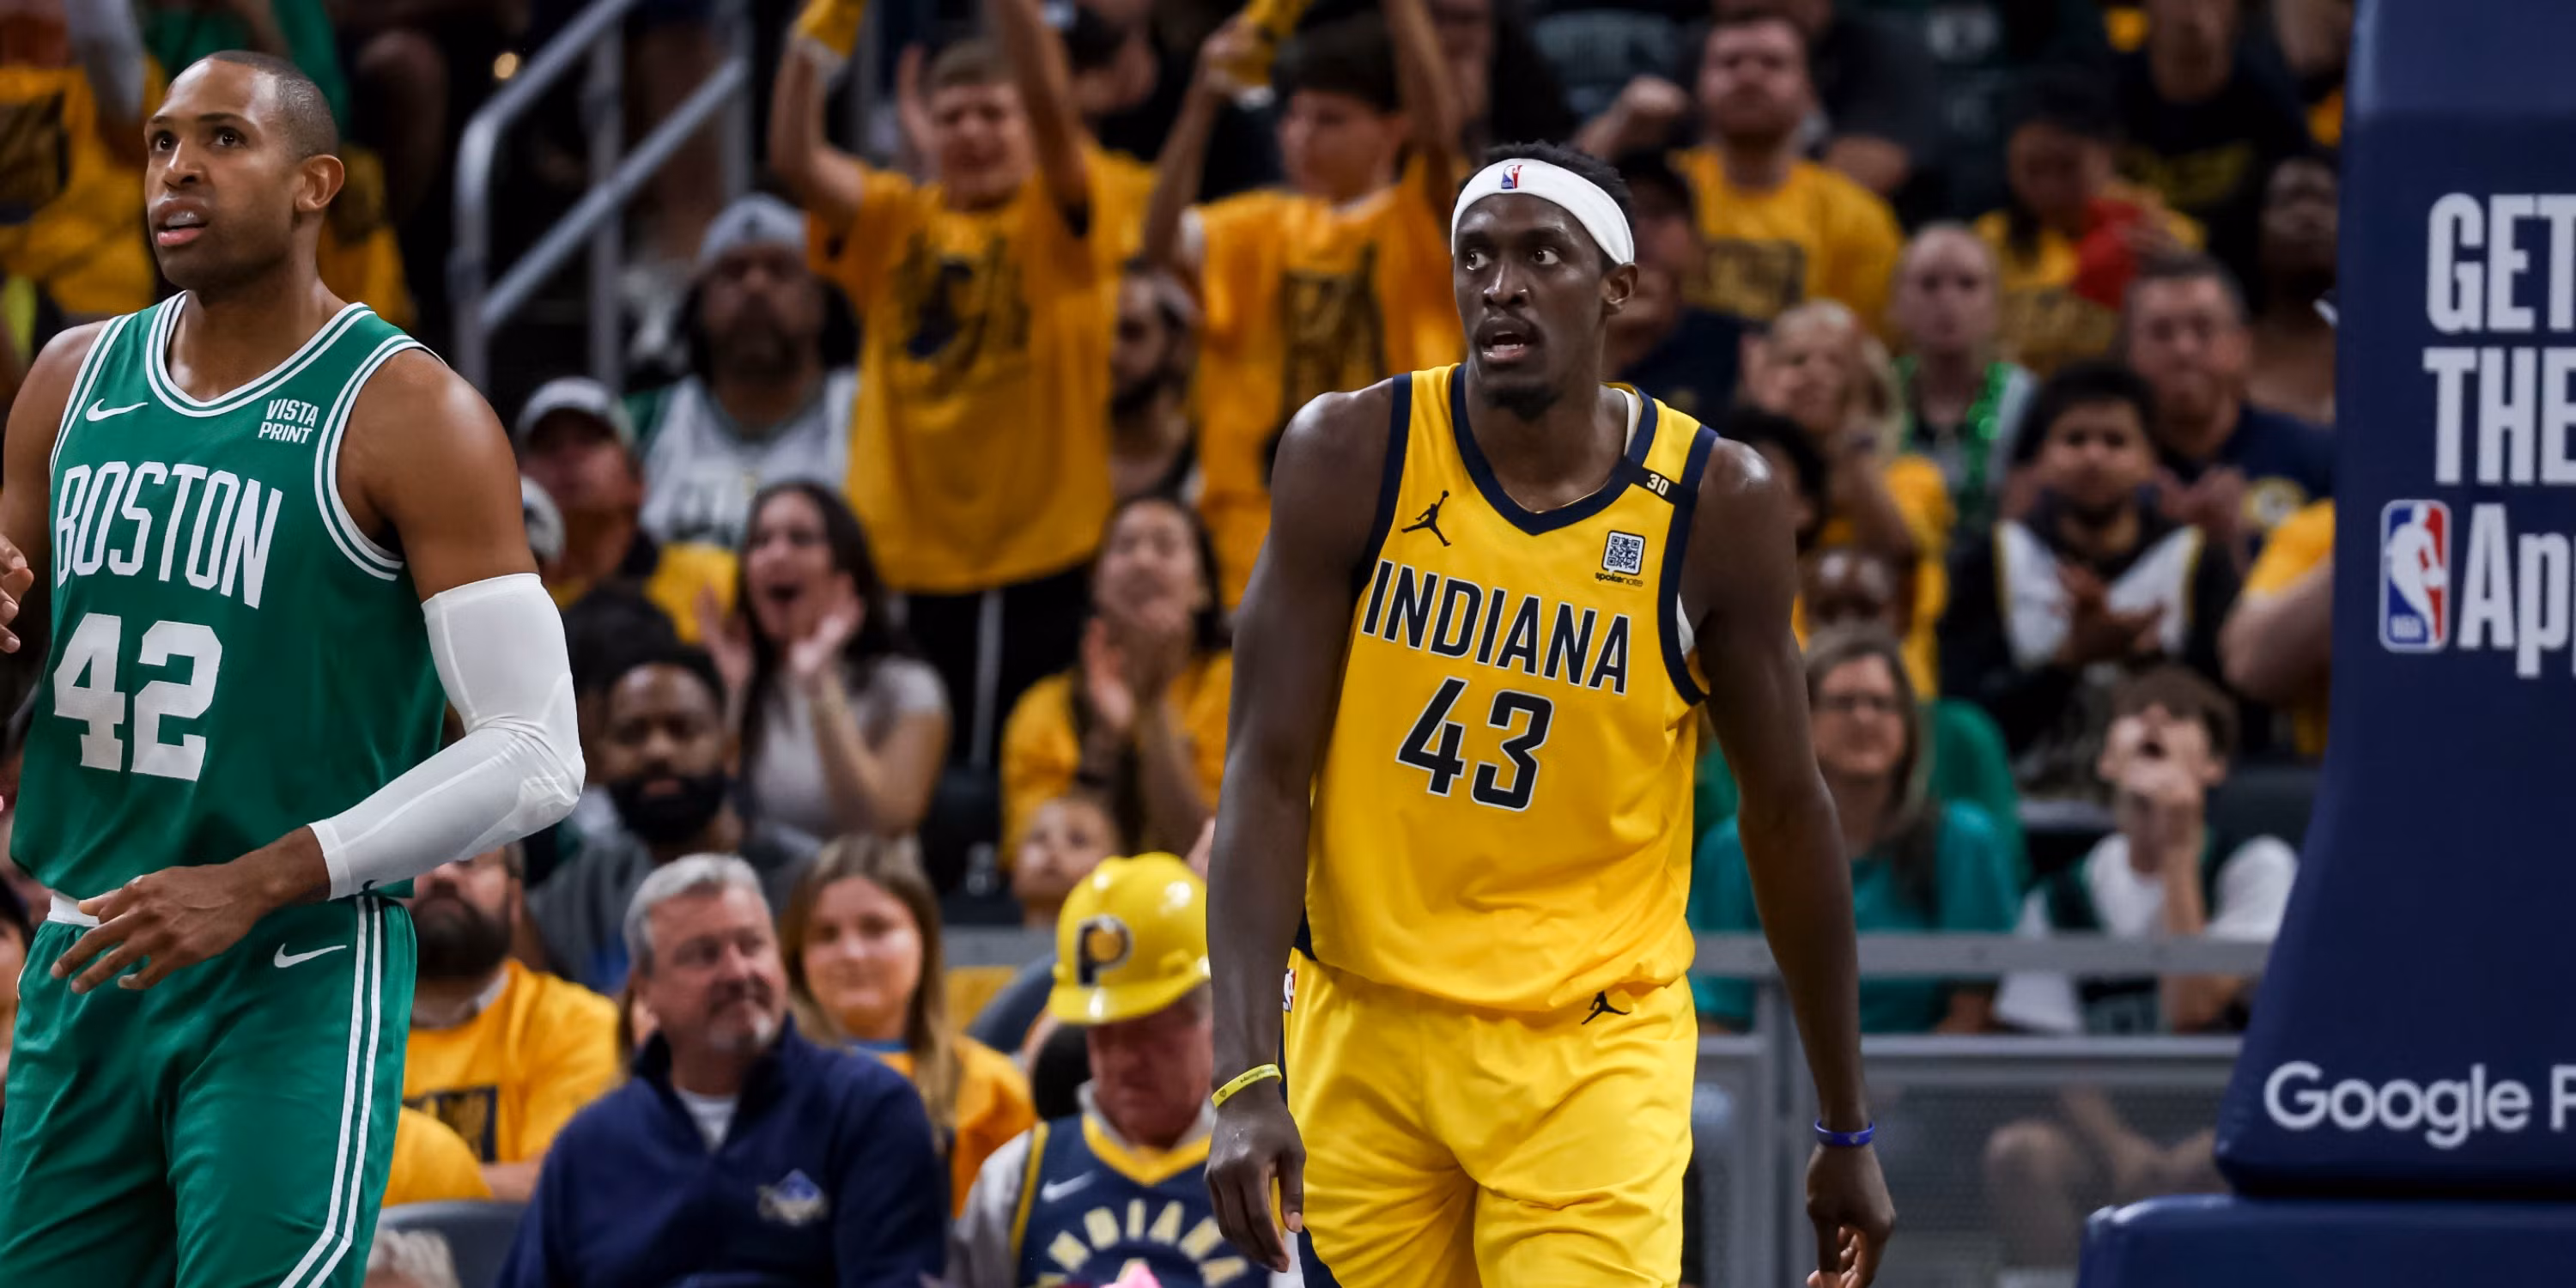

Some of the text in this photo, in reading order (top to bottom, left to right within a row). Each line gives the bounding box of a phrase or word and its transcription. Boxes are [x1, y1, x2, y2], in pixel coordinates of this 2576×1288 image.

[2427, 192, 2576, 333] GET
[258, 422, 313, 444] PRINT
[266, 398, 319, 428] VISTA
[2422, 347, 2576, 486] THE
[56, 461, 283, 610] BOSTON
[1646, 473, 1669, 496] 30
[1362, 559, 1630, 695] INDIANA
[1595, 572, 1643, 587] spokenote
[2457, 502, 2576, 677] Ap
[53, 612, 222, 781] 42
[1395, 675, 1554, 812] 43
[2263, 1061, 2531, 1149] Google
